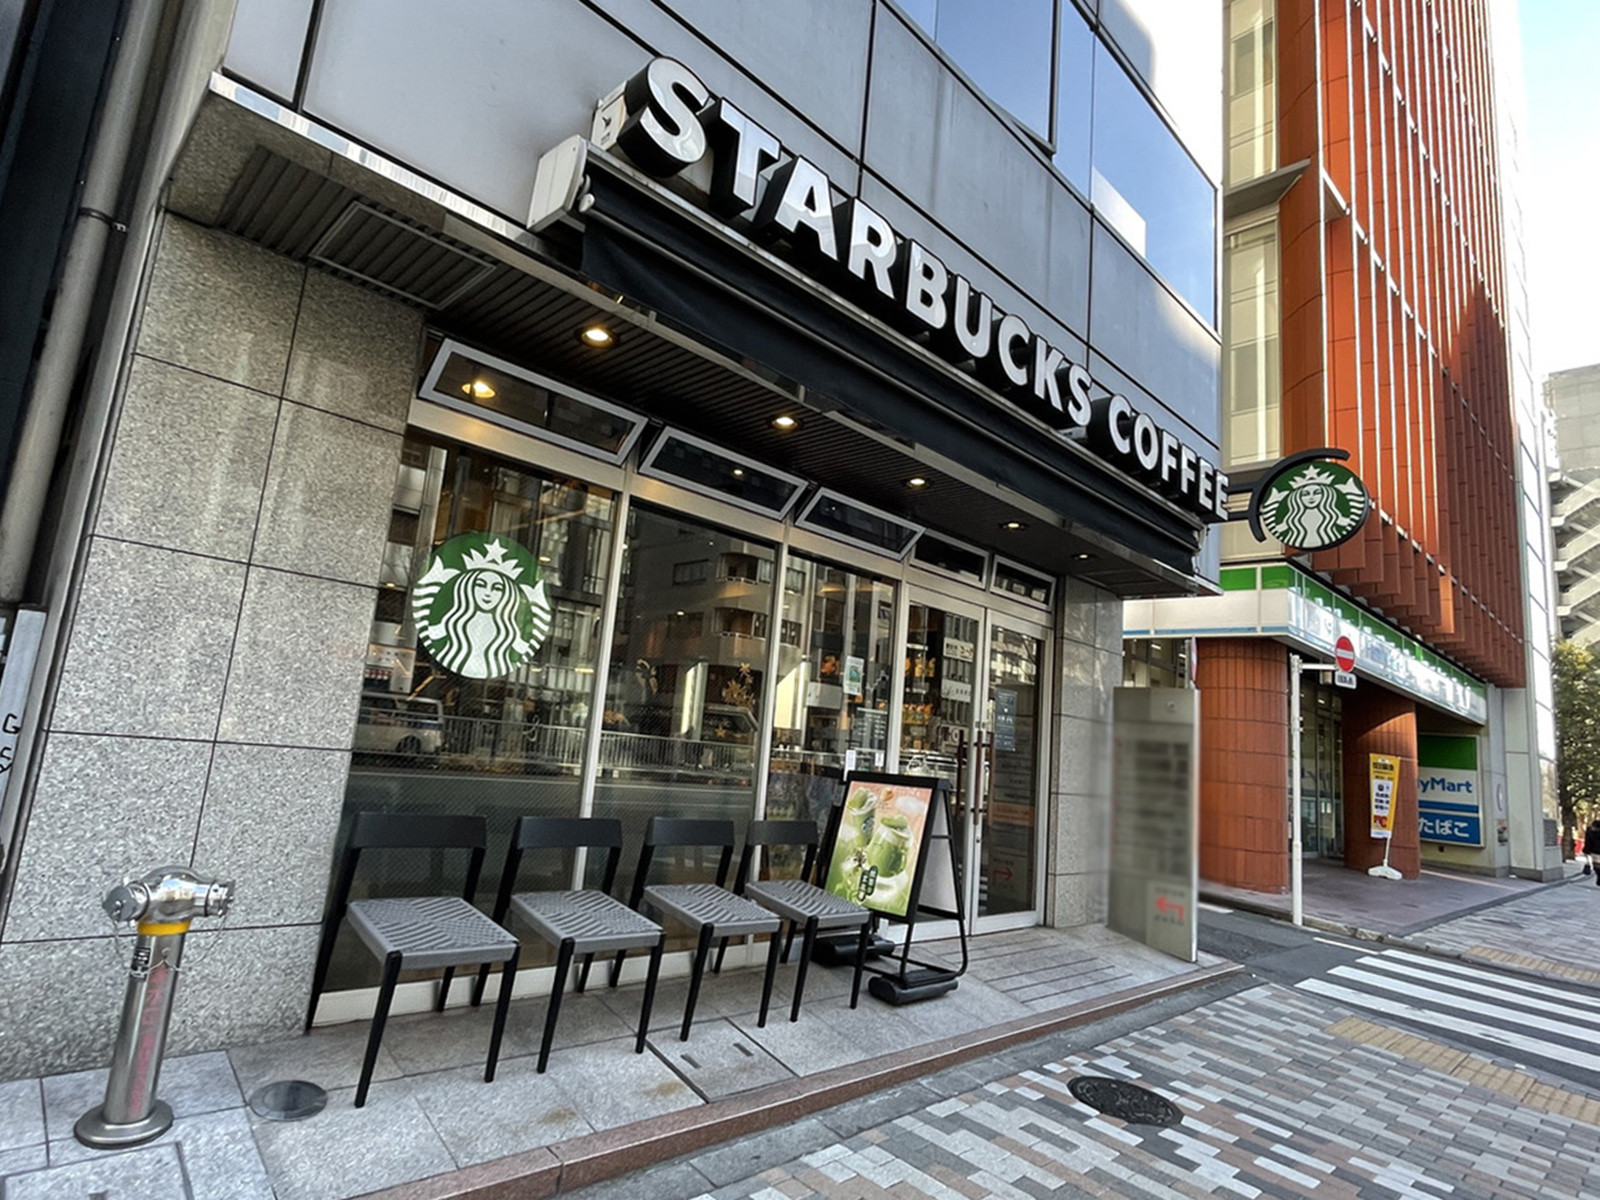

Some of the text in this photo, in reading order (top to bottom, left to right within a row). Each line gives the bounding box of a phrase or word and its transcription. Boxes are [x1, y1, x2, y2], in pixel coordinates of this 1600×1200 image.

[640, 56, 1230, 520] STARBUCKS COFFEE
[1418, 817, 1470, 837] たばこ
